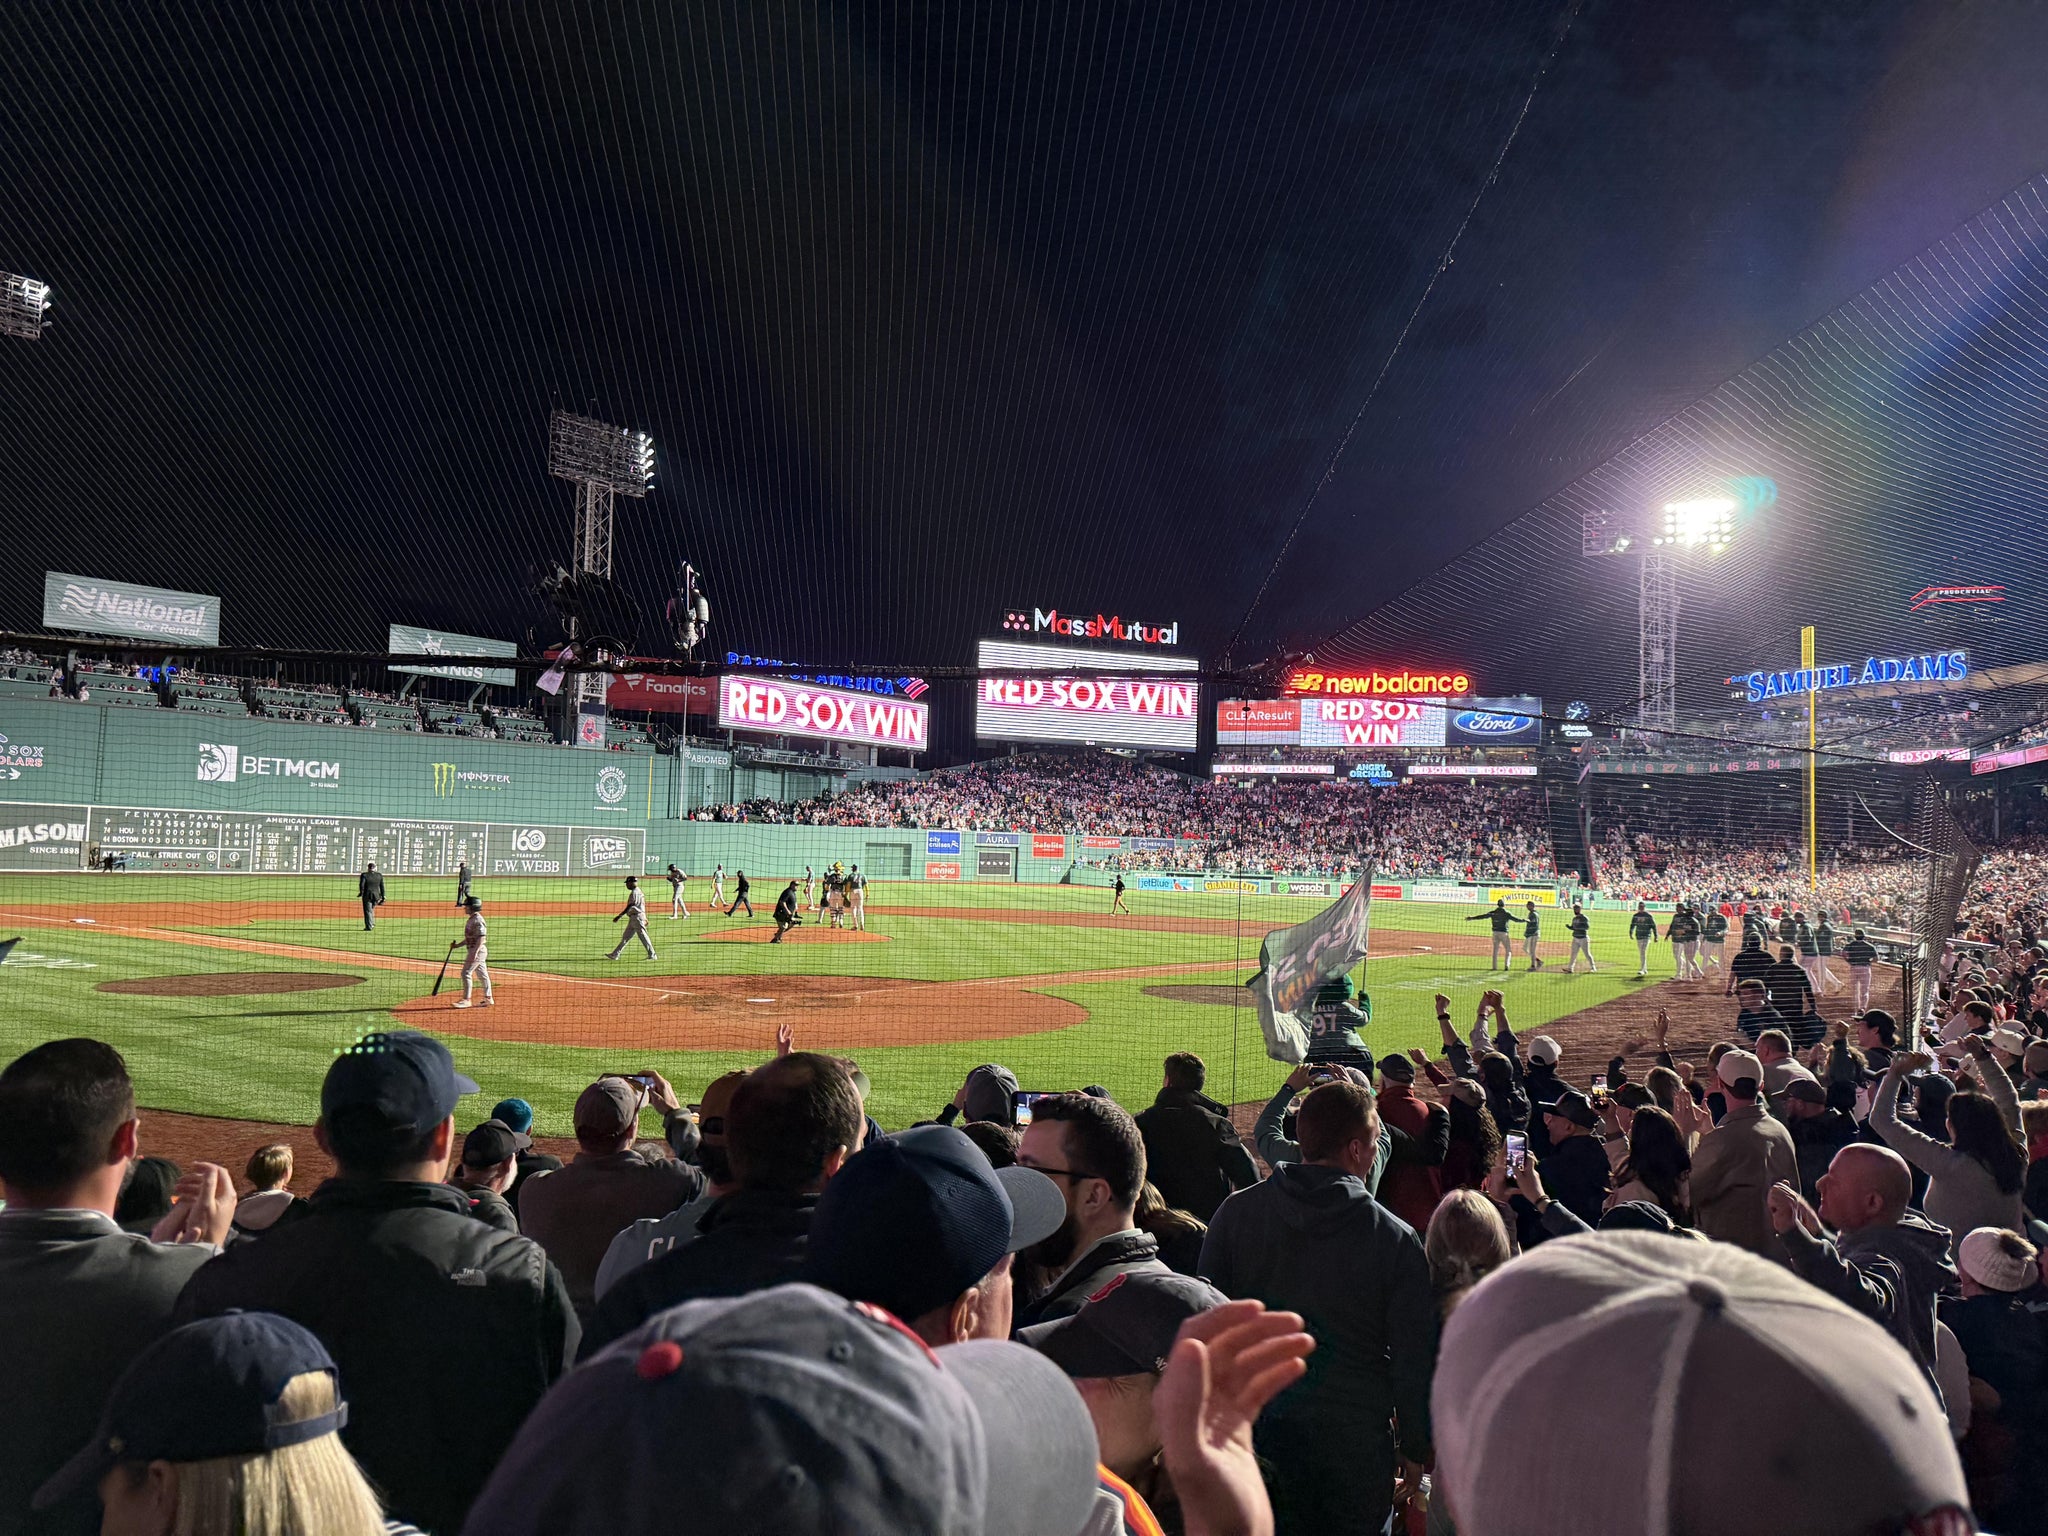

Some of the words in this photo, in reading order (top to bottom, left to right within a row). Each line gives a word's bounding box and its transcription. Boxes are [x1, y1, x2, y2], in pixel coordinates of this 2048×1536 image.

[135, 620, 153, 631] Car
[160, 625, 200, 637] Rental
[1034, 607, 1178, 645] MassMutual
[1747, 665, 1858, 702] SAMUEL
[1859, 651, 1968, 684] ADAMS
[645, 678, 707, 696] Fanatics
[1326, 677, 1371, 694] new
[1372, 672, 1469, 694] balance
[985, 679, 1044, 705] RED
[1051, 680, 1116, 710] SOX
[1126, 682, 1192, 716] WIN
[728, 681, 788, 724] RED
[795, 693, 856, 733] SOX
[863, 703, 923, 741] WIN
[1226, 711, 1292, 721] CLEAResult
[1322, 700, 1365, 721] RED
[1371, 701, 1421, 721] SOX
[1468, 711, 1517, 731] Ford
[1345, 723, 1400, 744] WIN
[8, 744, 45, 758] SOX
[1890, 751, 1913, 763] RED
[691, 754, 729, 765] ABIOMED
[1767, 760, 1781, 770] 34
[242, 755, 340, 780] BETMGM
[1726, 763, 1739, 772] 45
[1350, 770, 1393, 778] ORCHARD
[124, 810, 179, 820] FENWAY
[188, 813, 223, 821] PARK
[266, 816, 307, 825] AMERICAN
[150, 819, 155, 827] 2
[166, 820, 172, 828] 4
[173, 820, 179, 828] 5
[180, 820, 186, 828] 6
[196, 821, 202, 829] 8
[203, 821, 208, 829] 9
[391, 822, 424, 830] NATIONAL
[0, 822, 86, 849] MASON
[112, 835, 139, 843] BOSTON
[511, 828, 546, 851] 160
[29, 846, 58, 854] SINCE
[60, 847, 80, 855] 1898
[591, 838, 627, 852] ACE
[158, 851, 183, 859] STRIKE
[592, 851, 626, 863] TICKET
[645, 855, 660, 863] 379
[494, 860, 518, 873] F.W.
[521, 860, 560, 873] WEBB
[931, 866, 956, 875] IRVING
[1140, 878, 1170, 889] jetBlue
[1204, 880, 1240, 891] GRANITE
[1240, 882, 1258, 893] CITY
[1290, 883, 1325, 892] wasabi
[1312, 1013, 1337, 1036] 97
